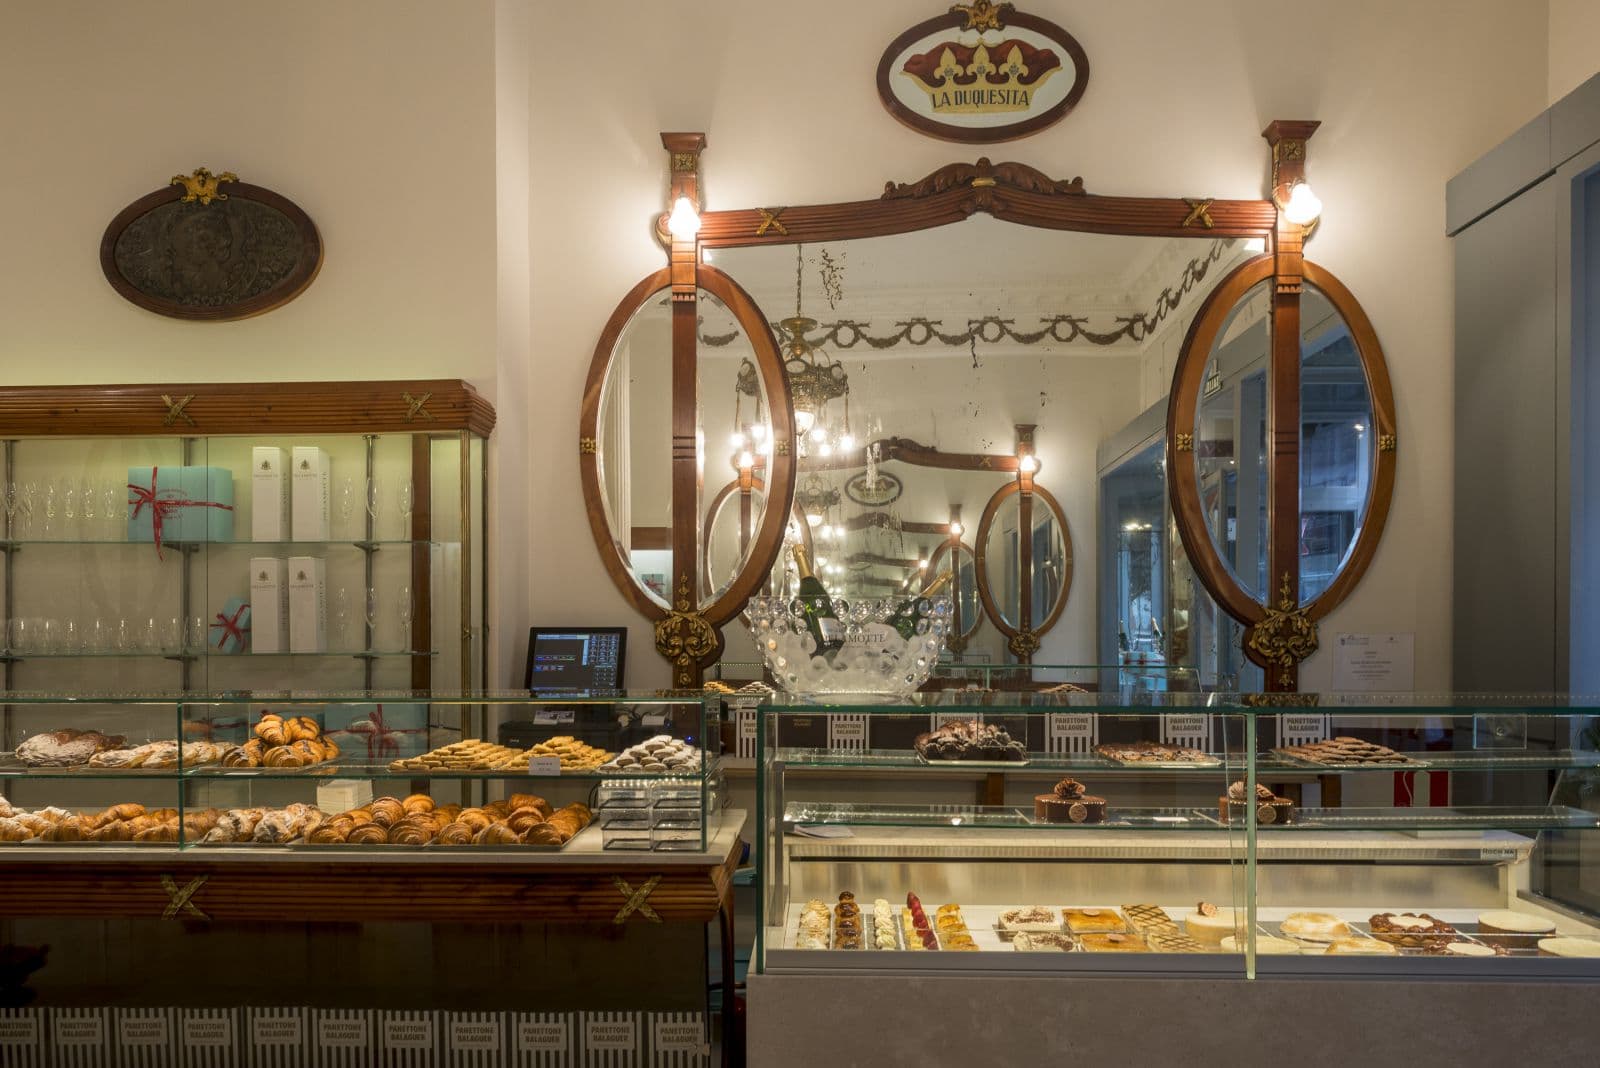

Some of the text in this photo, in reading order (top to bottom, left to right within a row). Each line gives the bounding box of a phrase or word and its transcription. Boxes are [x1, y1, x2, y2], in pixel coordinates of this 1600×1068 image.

[932, 89, 1029, 108] LA DUQUESITA
[389, 1024, 427, 1032] PANETTONE
